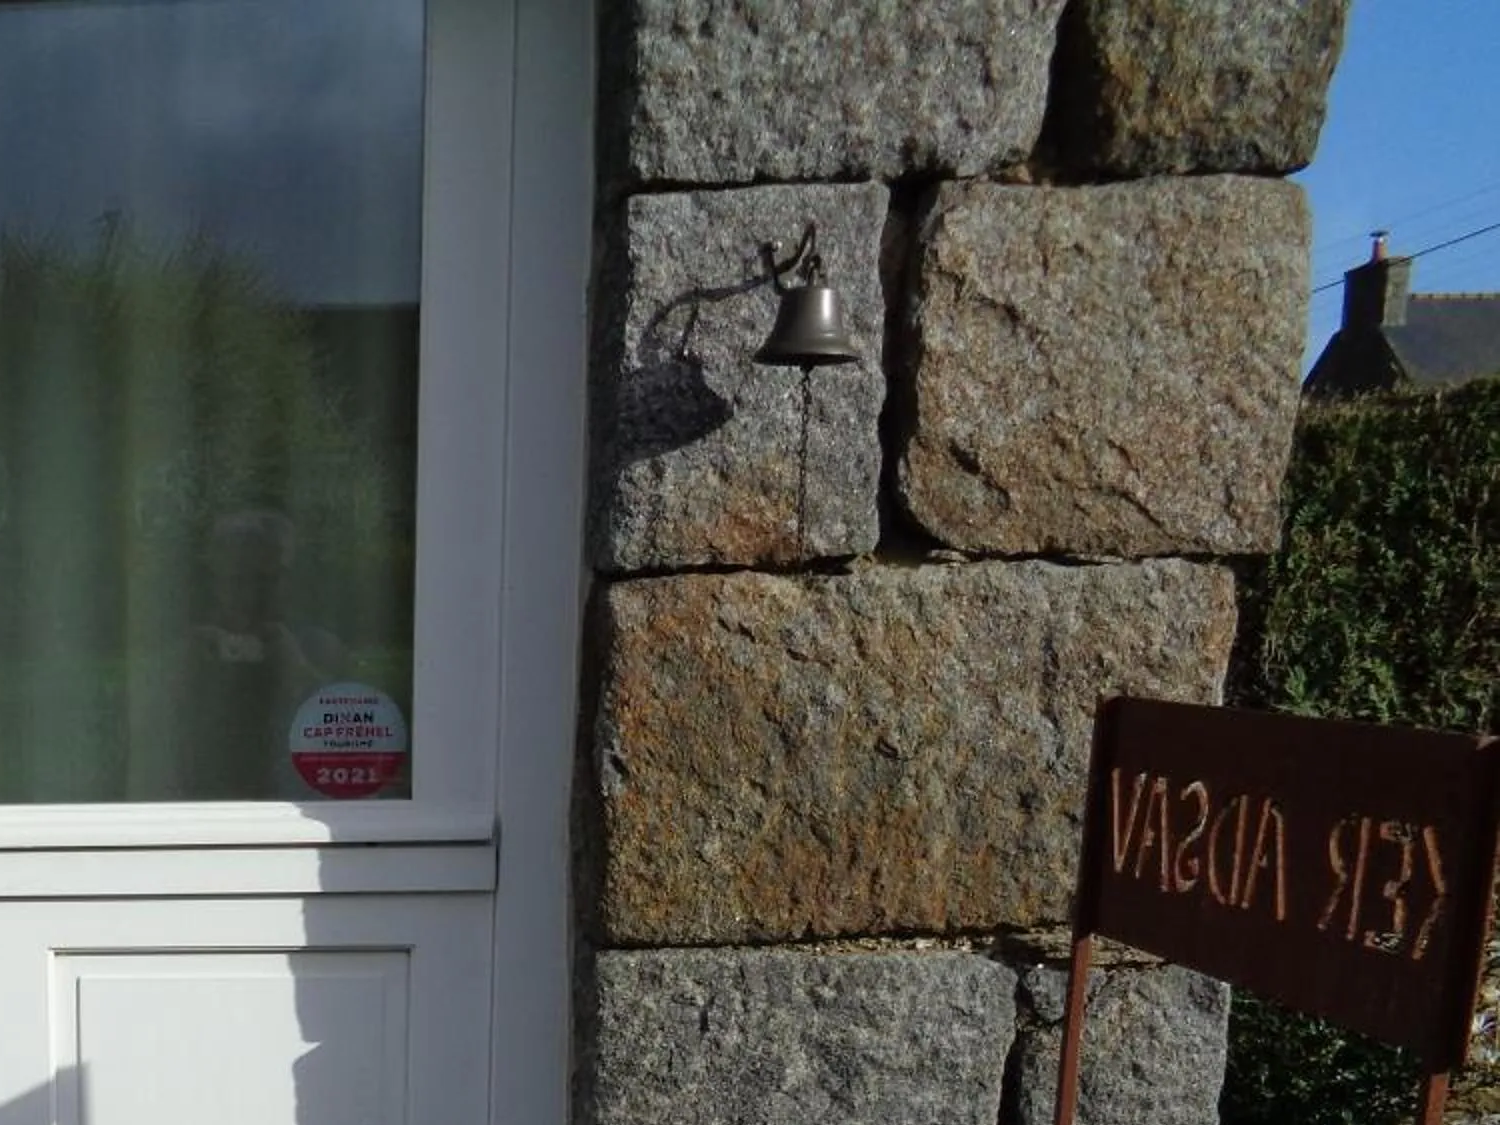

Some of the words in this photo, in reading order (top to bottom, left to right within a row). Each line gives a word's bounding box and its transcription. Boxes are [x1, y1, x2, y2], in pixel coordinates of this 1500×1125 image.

[323, 712, 374, 724] DINAN
[303, 726, 334, 738] CAP
[317, 767, 381, 784] 2021
